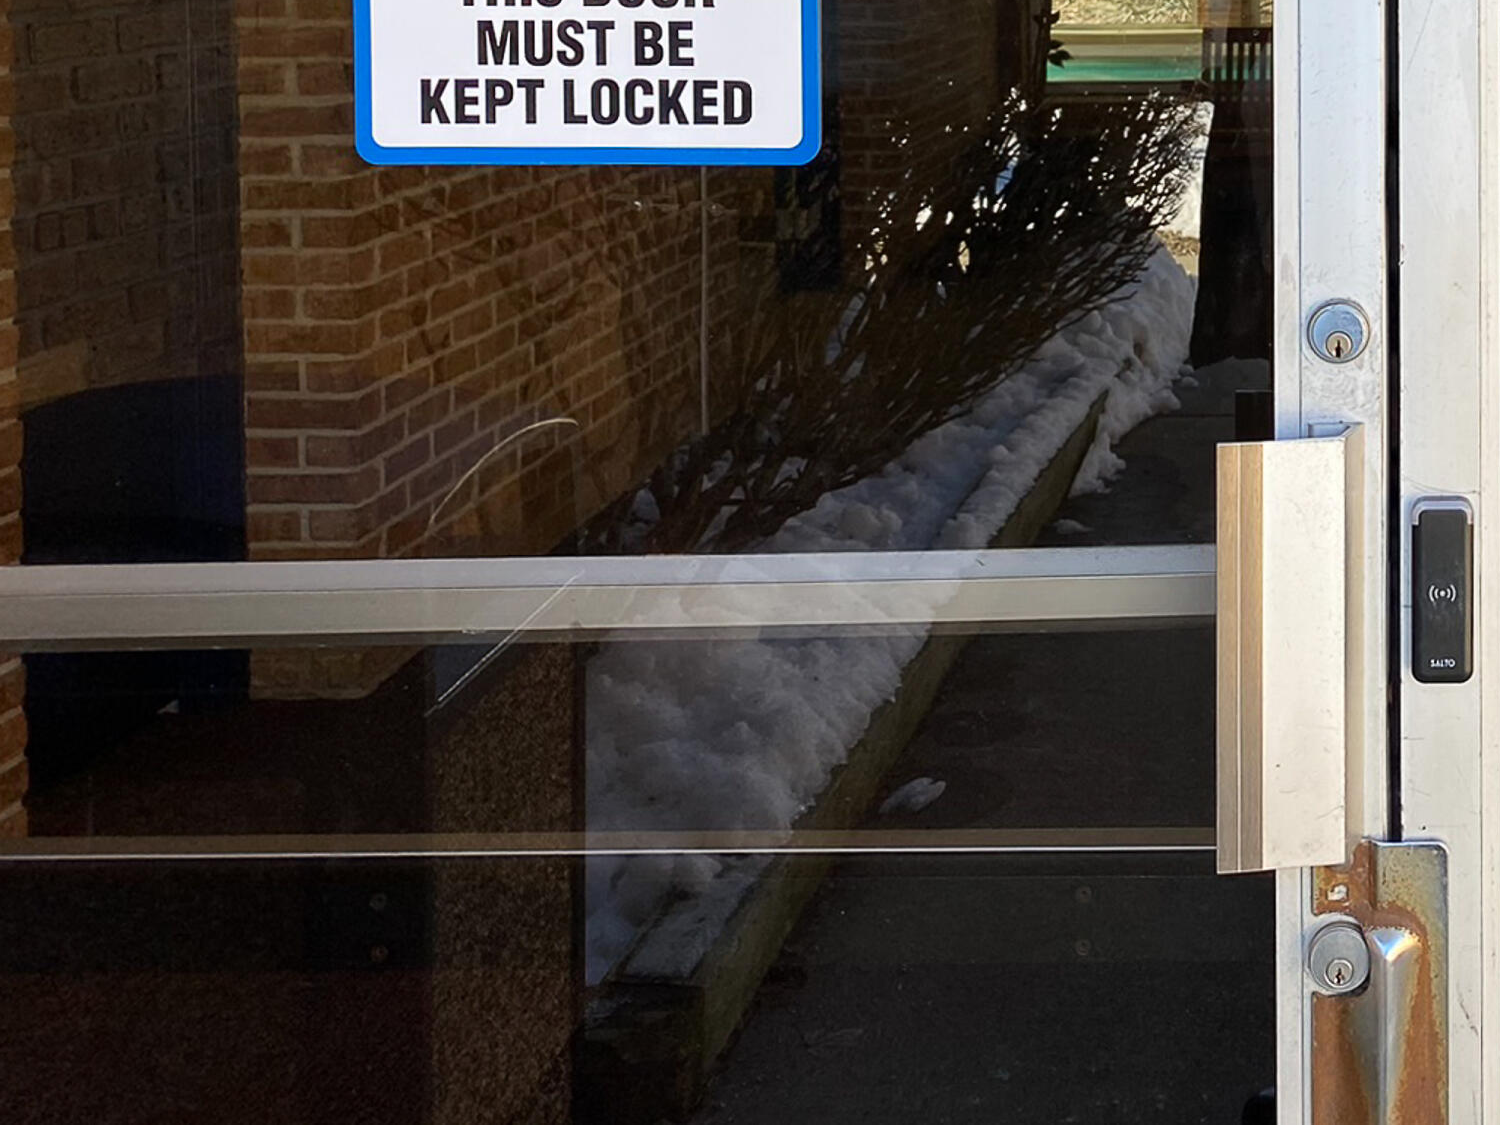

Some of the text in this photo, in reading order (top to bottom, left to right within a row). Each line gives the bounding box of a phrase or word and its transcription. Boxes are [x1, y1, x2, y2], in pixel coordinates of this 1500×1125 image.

[477, 19, 695, 67] MUST BE
[420, 78, 753, 125] KEPT LOCKED
[1430, 658, 1456, 668] SALTO
